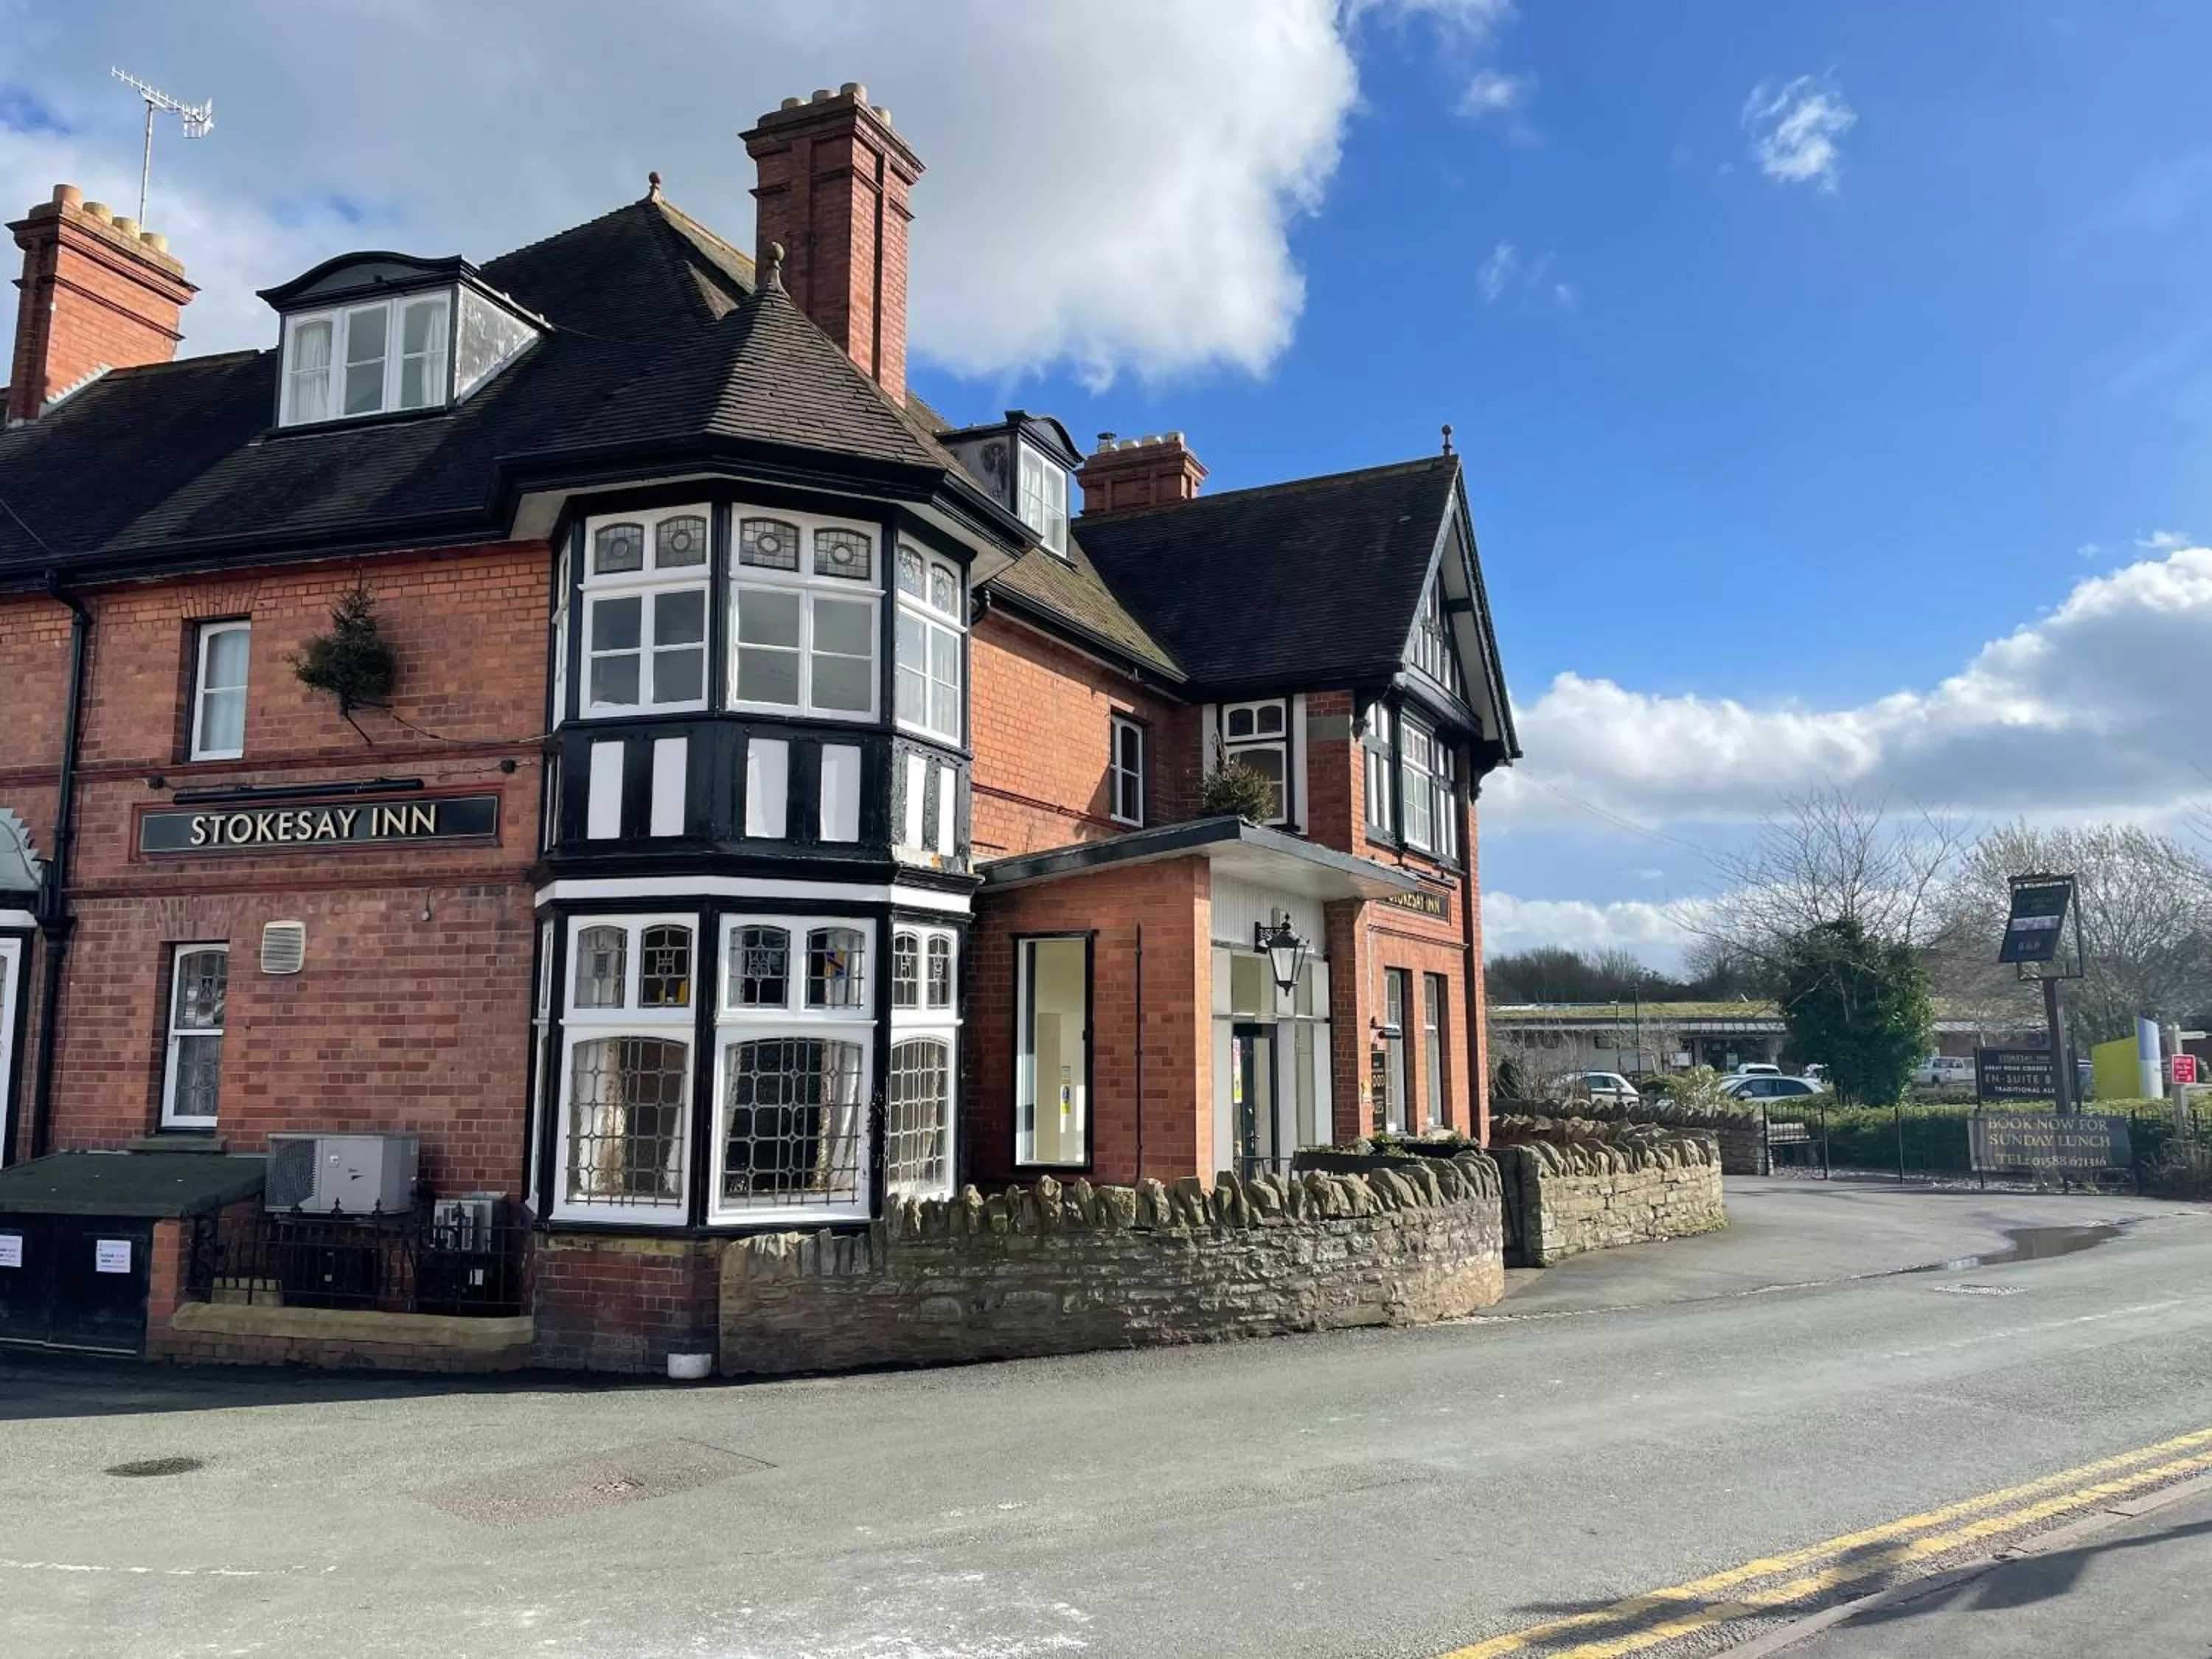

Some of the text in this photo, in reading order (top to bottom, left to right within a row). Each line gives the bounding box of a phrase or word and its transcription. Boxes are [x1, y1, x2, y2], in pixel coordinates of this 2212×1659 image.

[189, 804, 437, 846] STOKESAY INN
[1989, 1117, 2109, 1132] BOOK NOW FOR
[1989, 1133, 2110, 1148] SUNDAY LUNCH
[2031, 1155, 2067, 1167] 01588
